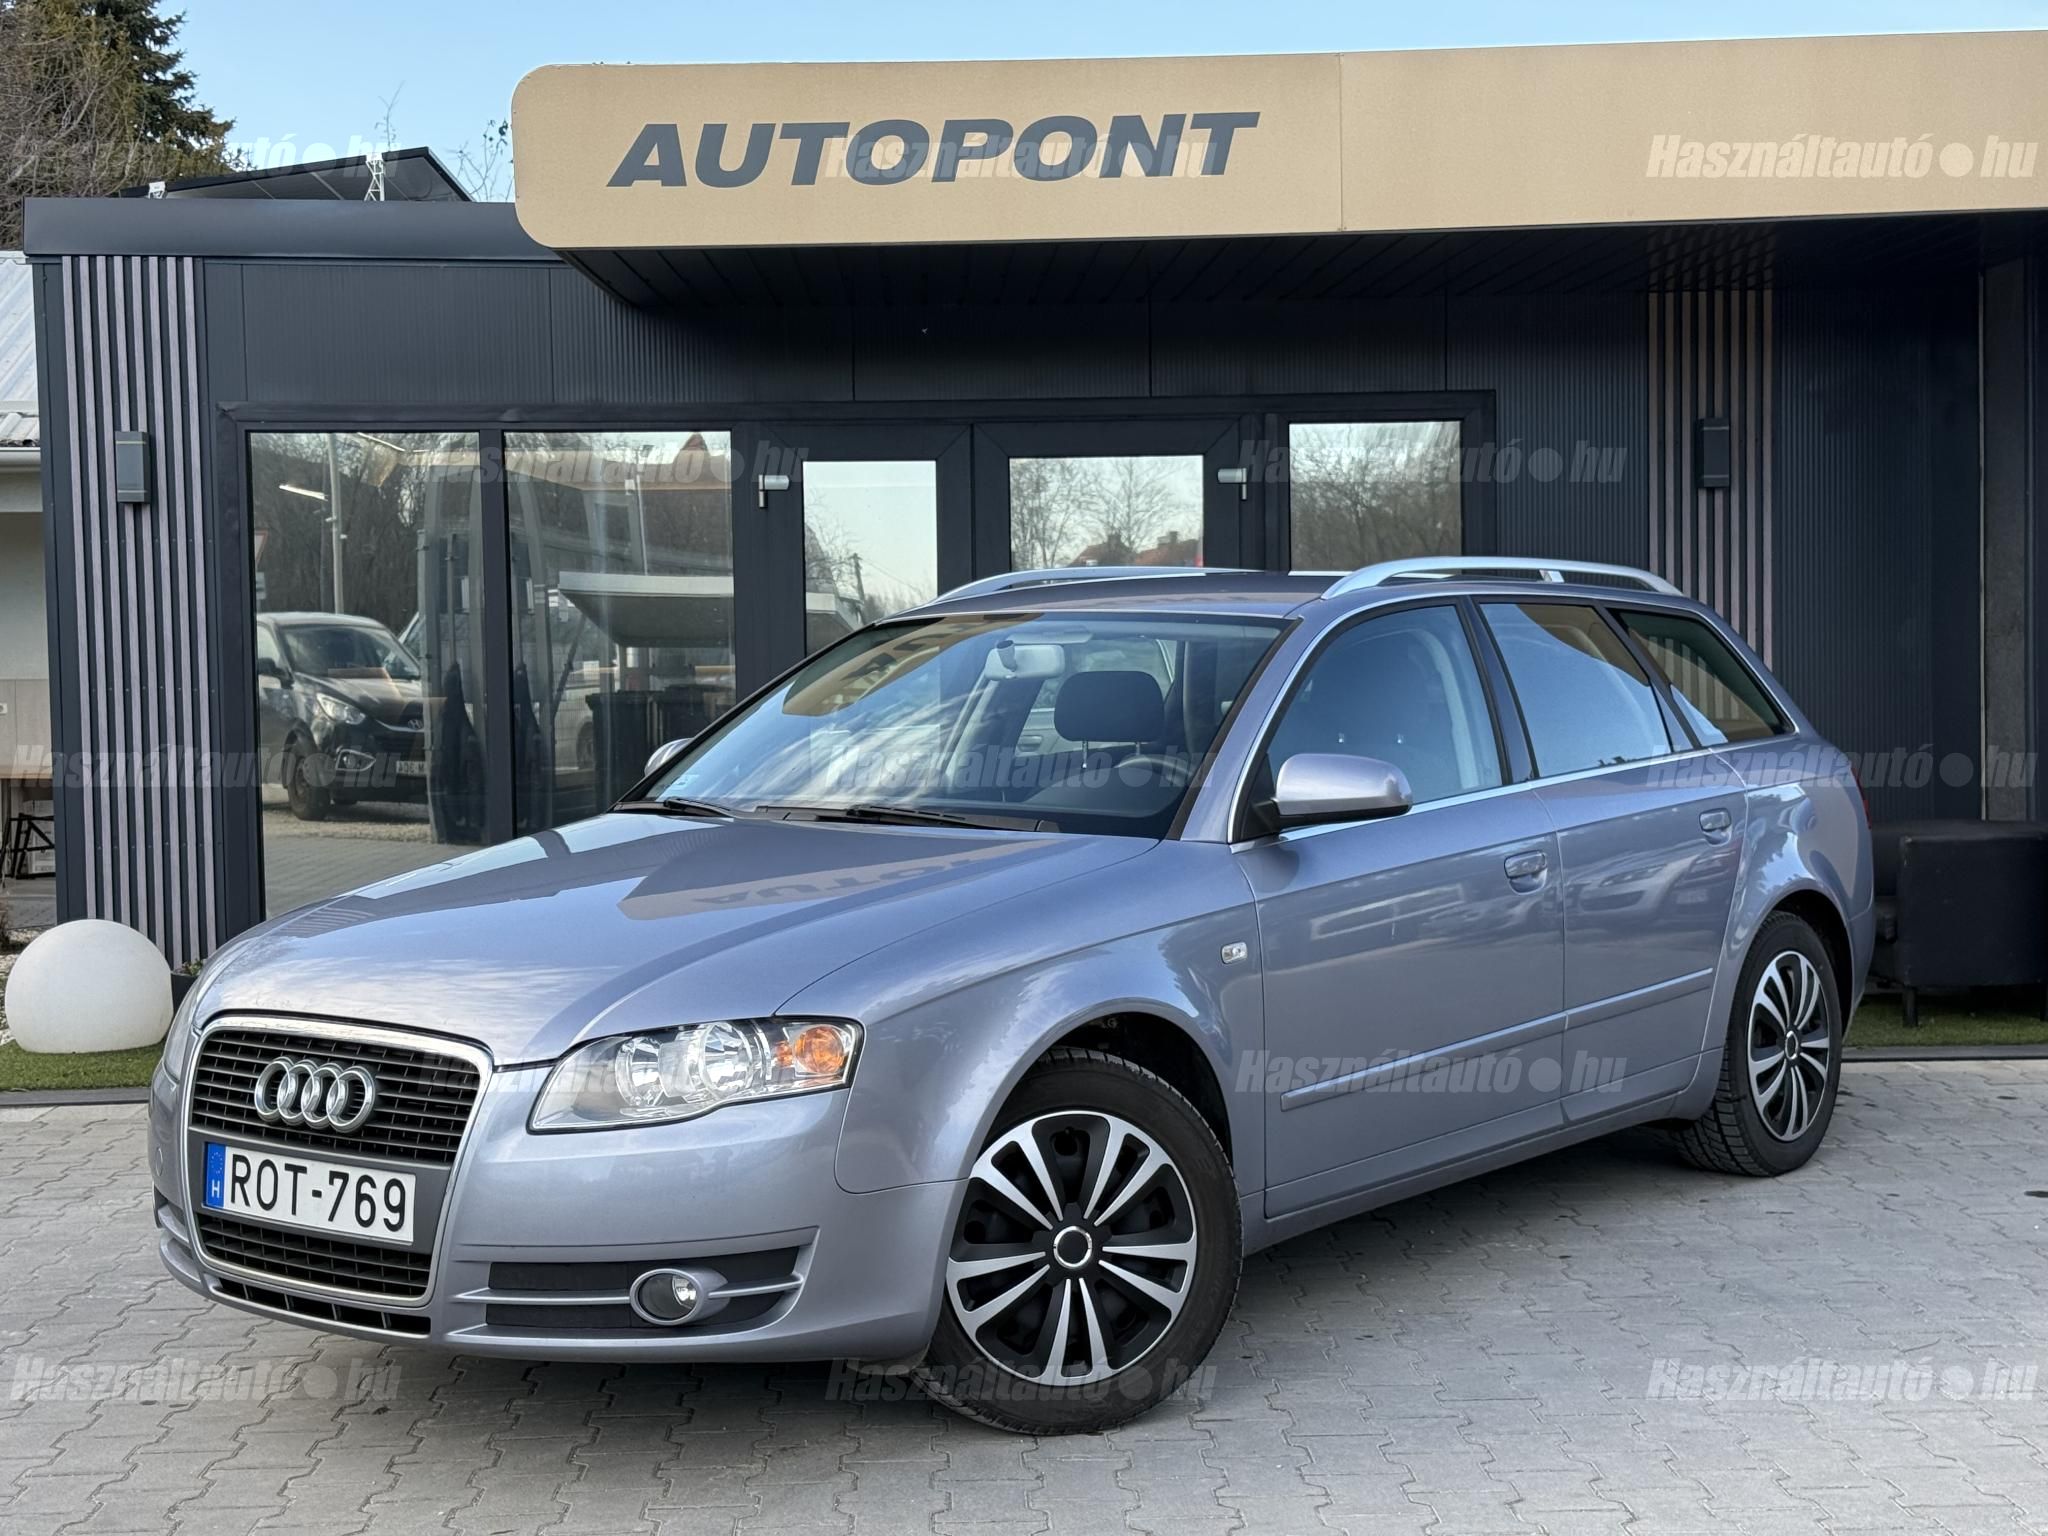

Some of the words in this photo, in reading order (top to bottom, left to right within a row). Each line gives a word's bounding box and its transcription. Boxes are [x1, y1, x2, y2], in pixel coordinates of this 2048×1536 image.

[606, 112, 1260, 188] AUTOPONT
[211, 1180, 220, 1199] H
[230, 1153, 406, 1233] ROT-769
